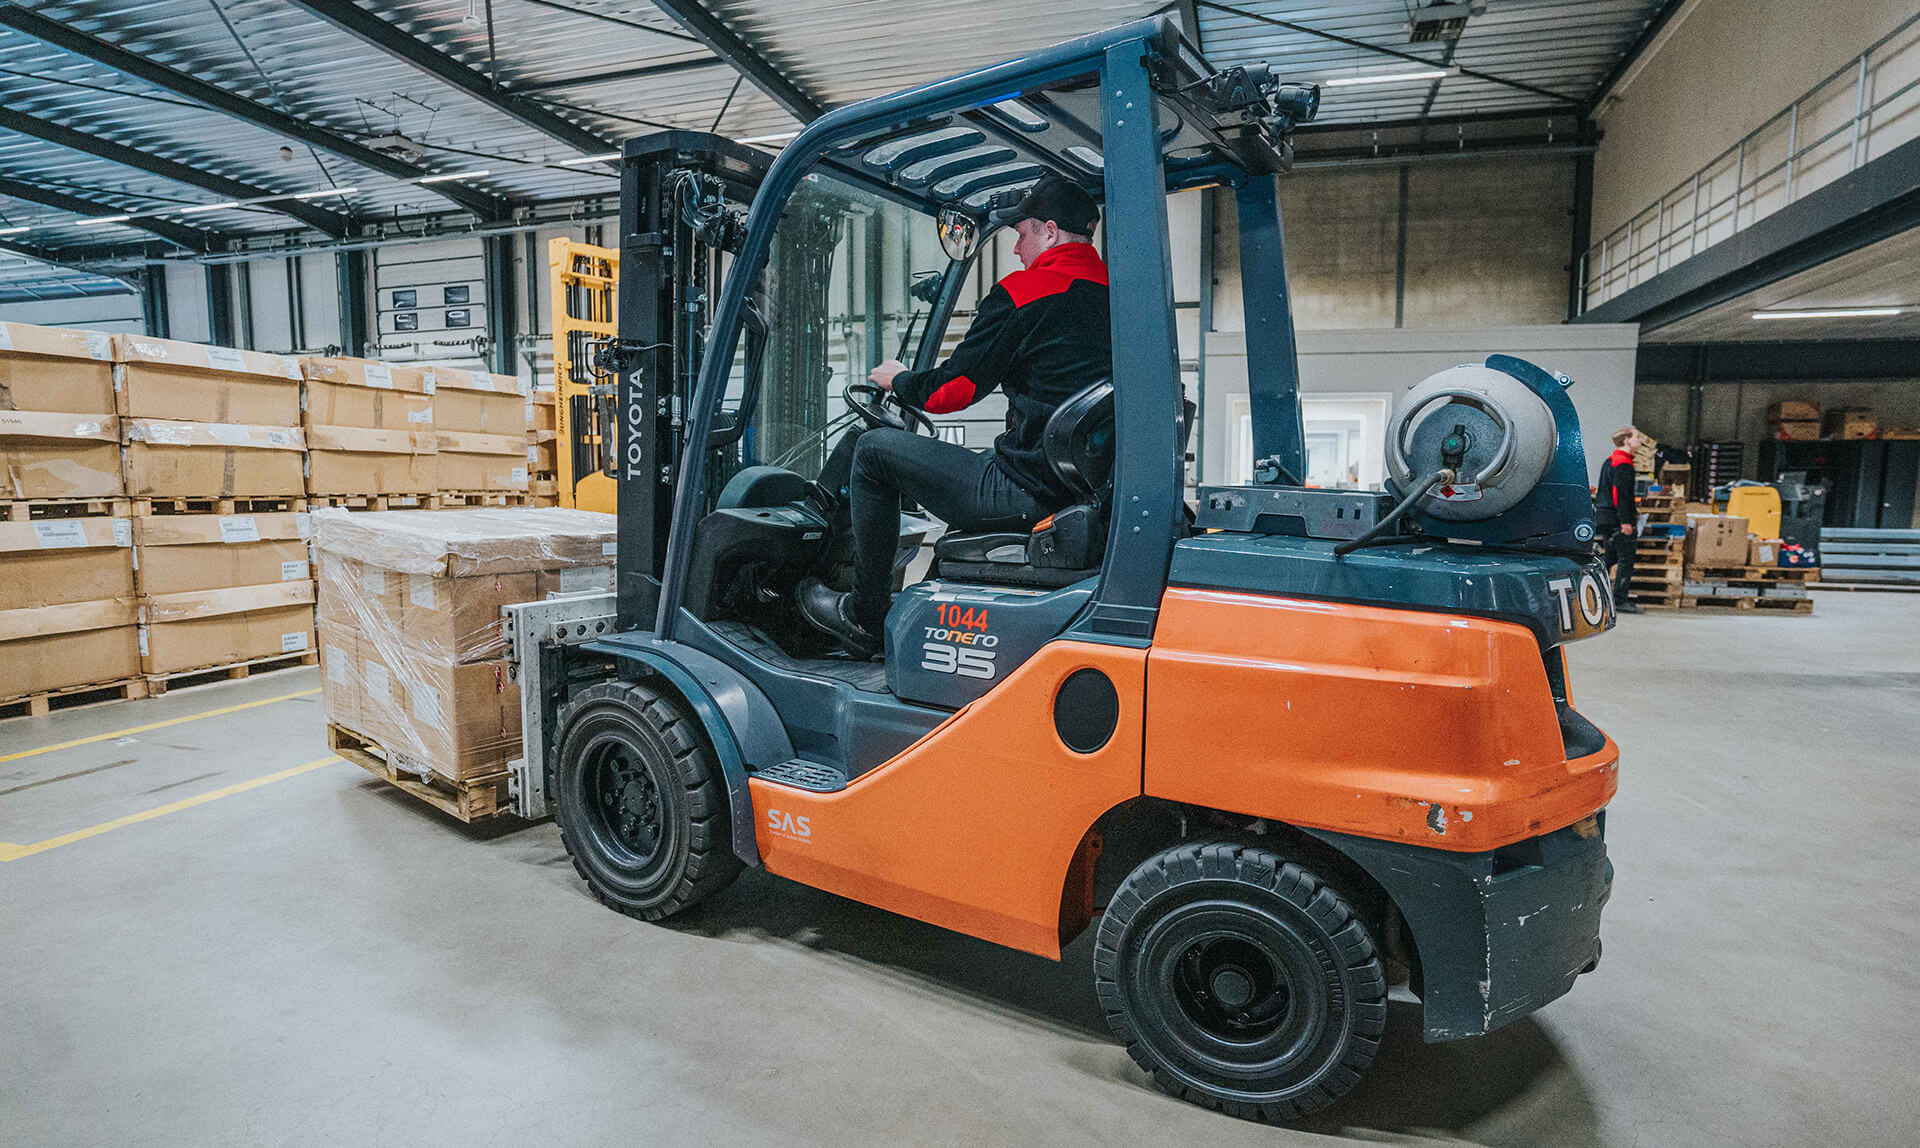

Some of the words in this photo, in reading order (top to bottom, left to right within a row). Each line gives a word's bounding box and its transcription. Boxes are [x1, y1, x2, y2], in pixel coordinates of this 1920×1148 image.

[557, 362, 565, 435] JUNGHEINRICH
[627, 367, 643, 481] TOYOTA
[936, 602, 989, 633] 1044
[921, 642, 997, 680] 35
[767, 808, 811, 837] SAS
